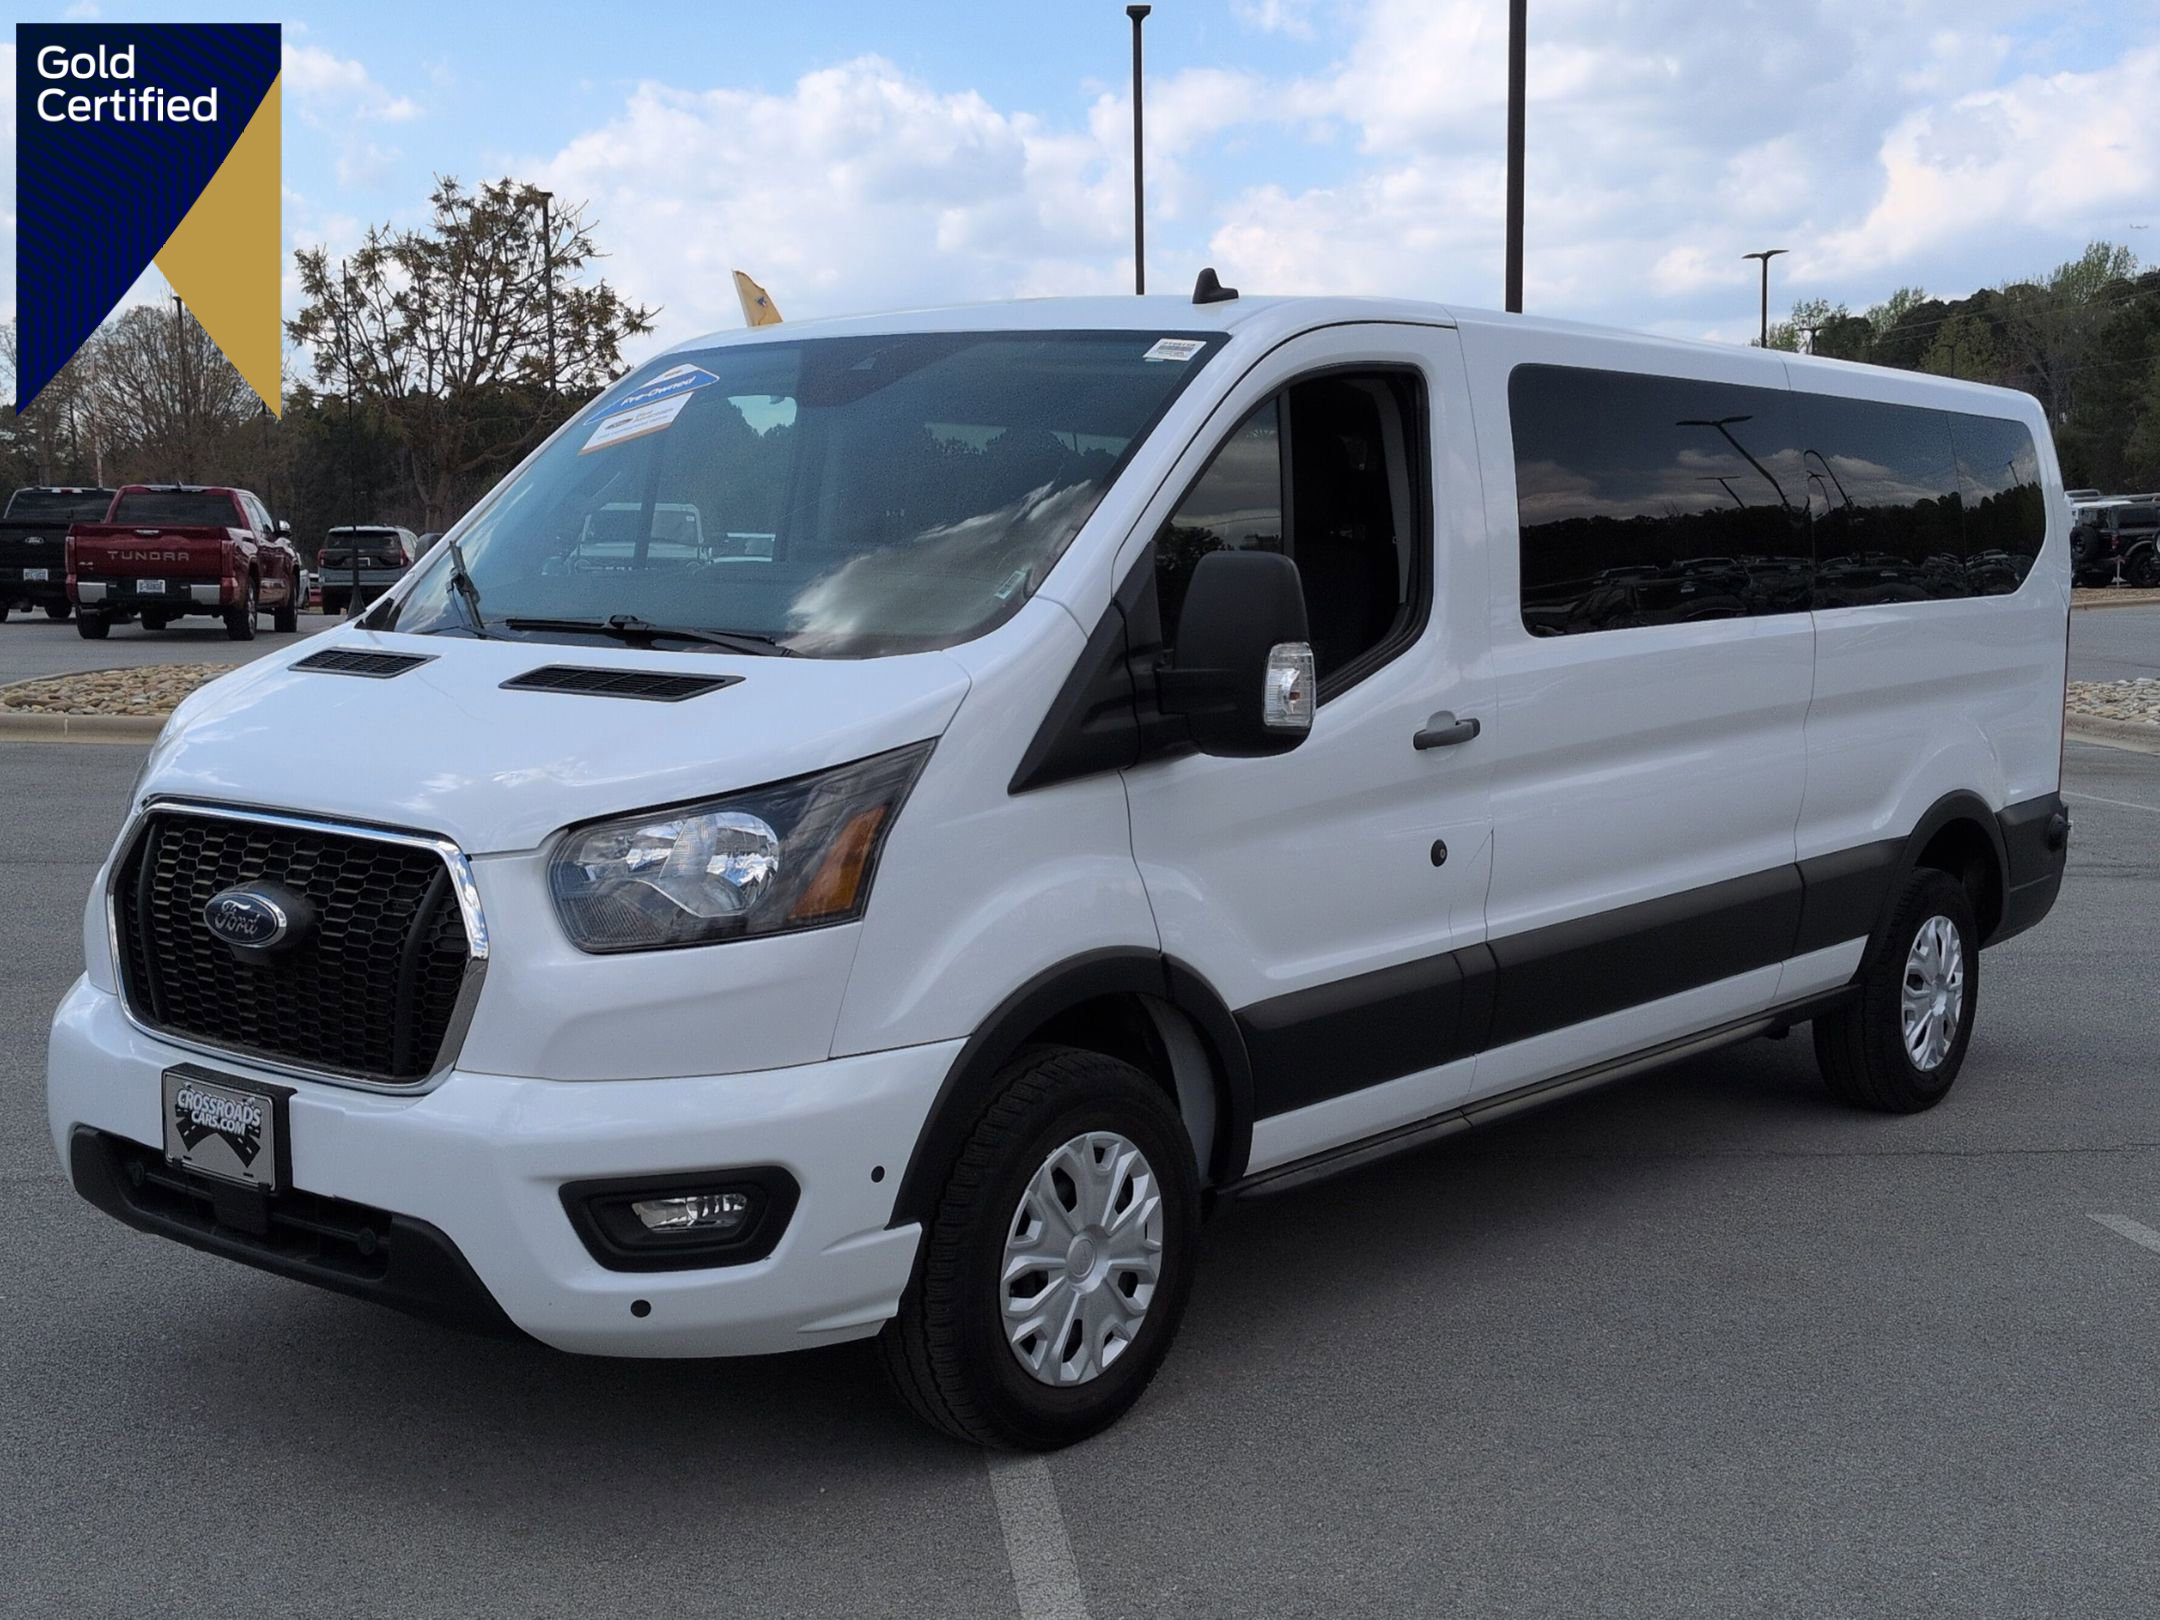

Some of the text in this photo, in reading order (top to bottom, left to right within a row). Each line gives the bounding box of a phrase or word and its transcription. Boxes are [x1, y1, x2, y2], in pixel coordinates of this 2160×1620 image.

[107, 550, 190, 561] TUNDRA
[214, 900, 259, 935] Ford
[177, 1088, 262, 1127] CROSSROADS
[191, 1109, 246, 1136] CARS.COM
